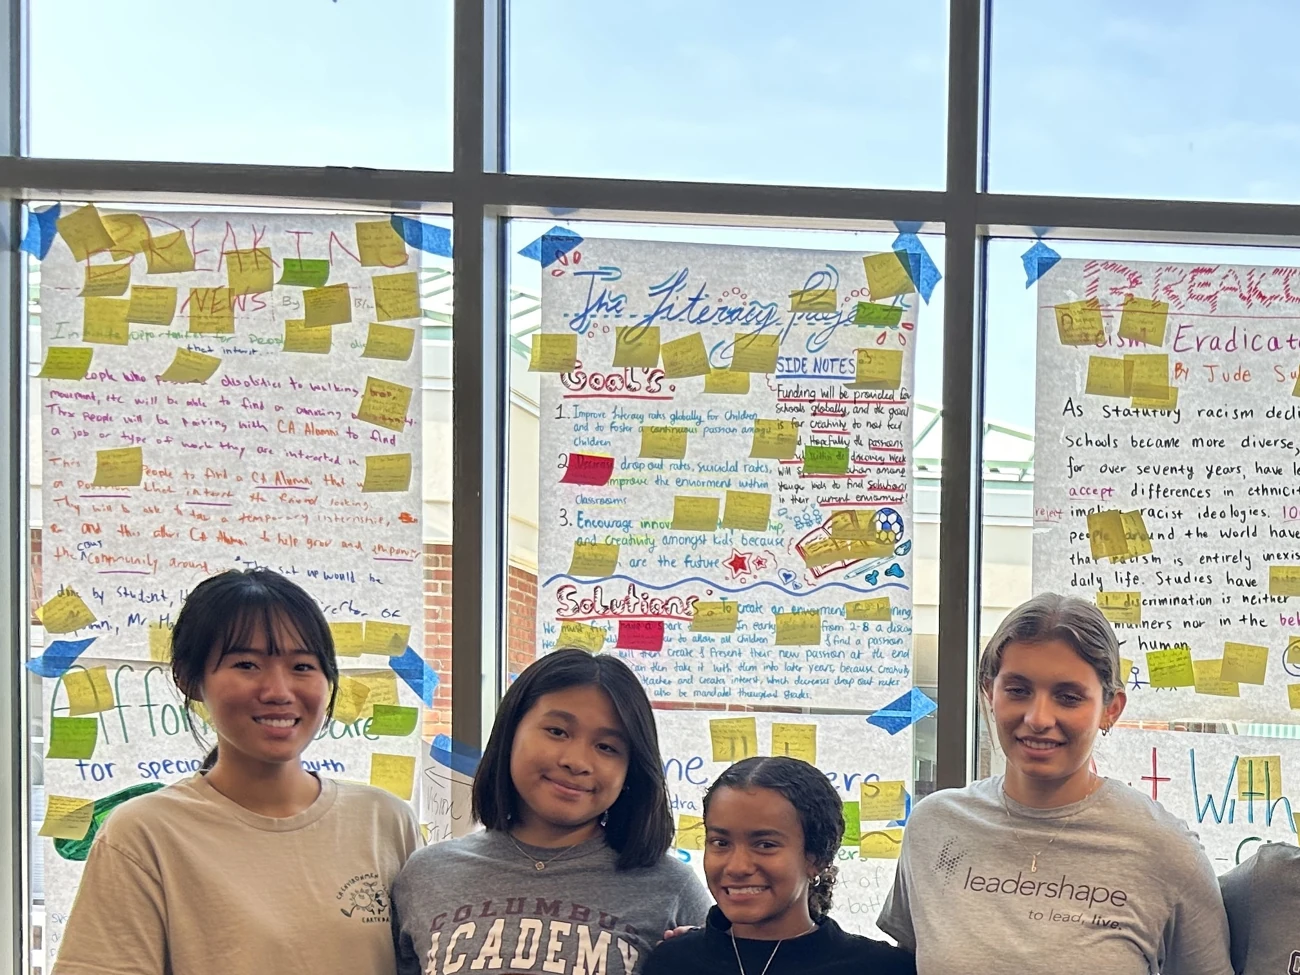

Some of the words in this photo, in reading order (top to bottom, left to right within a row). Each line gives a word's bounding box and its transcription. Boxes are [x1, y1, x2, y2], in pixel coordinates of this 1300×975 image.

[777, 357, 807, 373] SIDE
[814, 357, 856, 374] NOTES
[1174, 362, 1189, 381] By
[1203, 364, 1252, 383] Jude
[777, 384, 816, 403] Funding
[1062, 397, 1084, 417] As
[1198, 404, 1254, 420] racism
[277, 419, 295, 434] CA
[1130, 435, 1180, 448] became
[1192, 437, 1226, 448] more
[1241, 435, 1300, 456] diverse,
[1067, 456, 1085, 479] for
[1100, 463, 1127, 473] over
[1136, 464, 1194, 480] seventy
[1206, 465, 1246, 480] years,
[1255, 461, 1283, 476] have
[1069, 486, 1115, 501] accept
[1130, 483, 1211, 500] differences
[1223, 486, 1234, 496] in
[1035, 508, 1064, 520] reject
[1198, 504, 1270, 523] ideologies.
[1184, 527, 1208, 539] the
[1200, 549, 1252, 571] entirely
[1115, 571, 1145, 588] life.
[1156, 571, 1213, 585] Studies
[1226, 571, 1258, 587] have
[1124, 594, 1212, 606] discrimination
[1183, 619, 1206, 629] nor
[1239, 613, 1268, 628] the
[302, 759, 345, 773] outh
[1189, 748, 1297, 834] With
[964, 867, 1128, 909] leadershape
[1028, 909, 1044, 921] to
[1048, 909, 1086, 925] lead,
